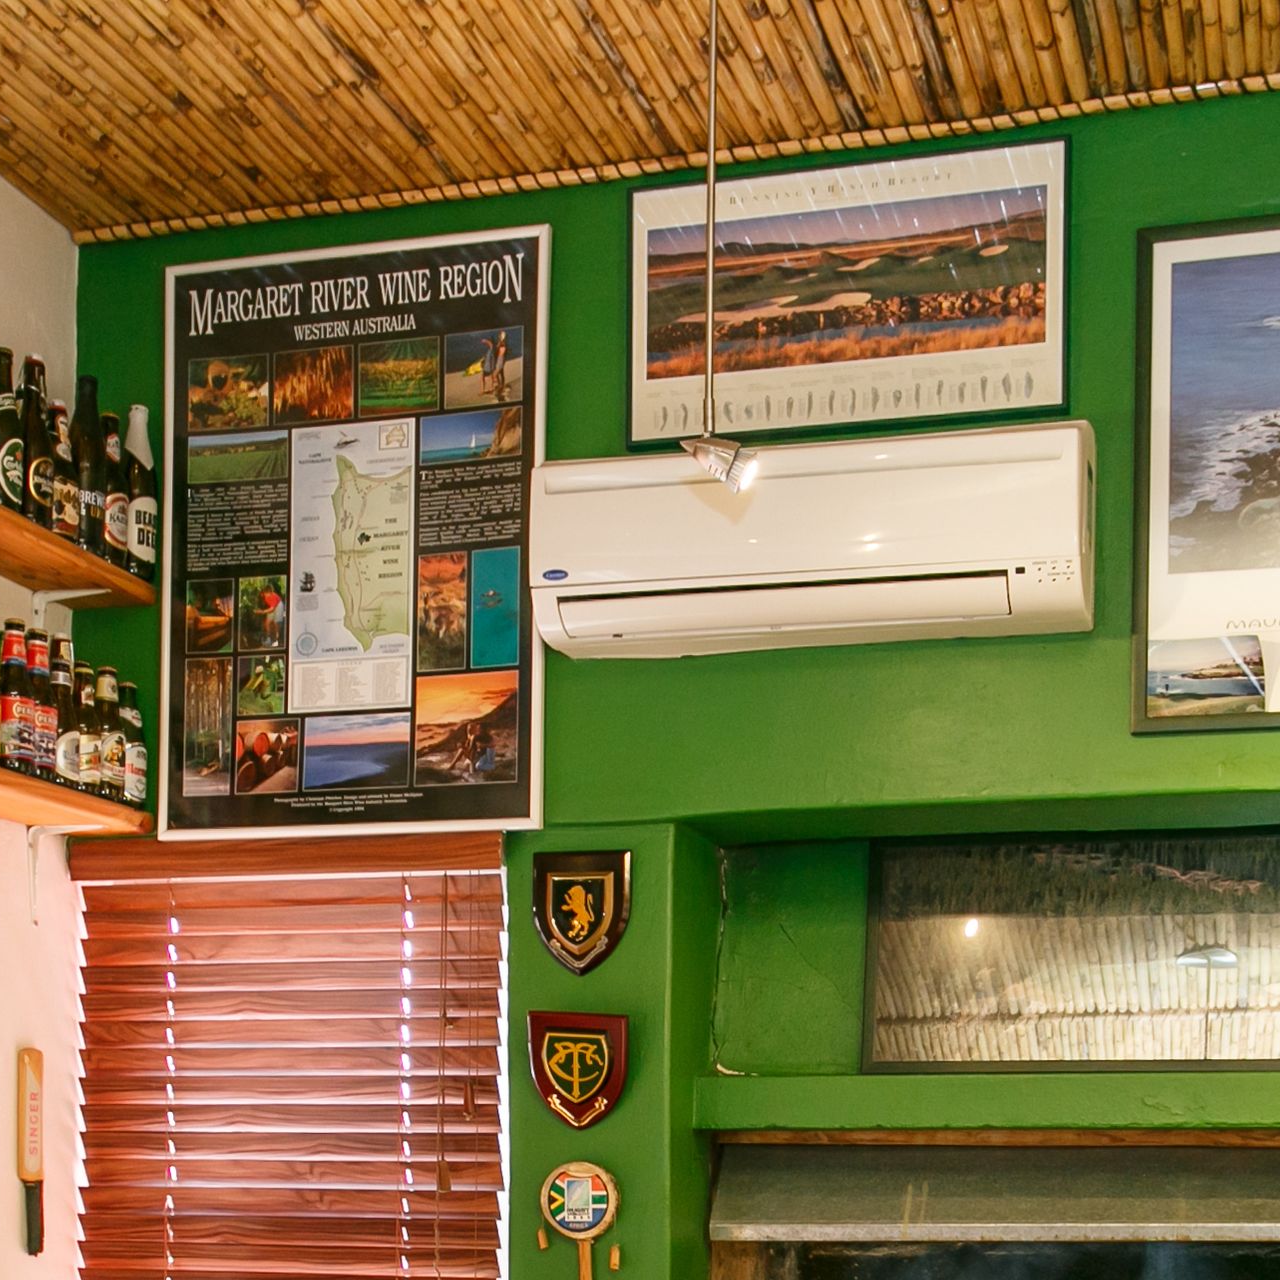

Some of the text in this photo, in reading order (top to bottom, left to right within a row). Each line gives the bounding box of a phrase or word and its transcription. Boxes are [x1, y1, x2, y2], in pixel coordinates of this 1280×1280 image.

[188, 252, 525, 337] MARGARET RIVER WINE REGION
[293, 313, 417, 343] WESTERN AUSTRALIA
